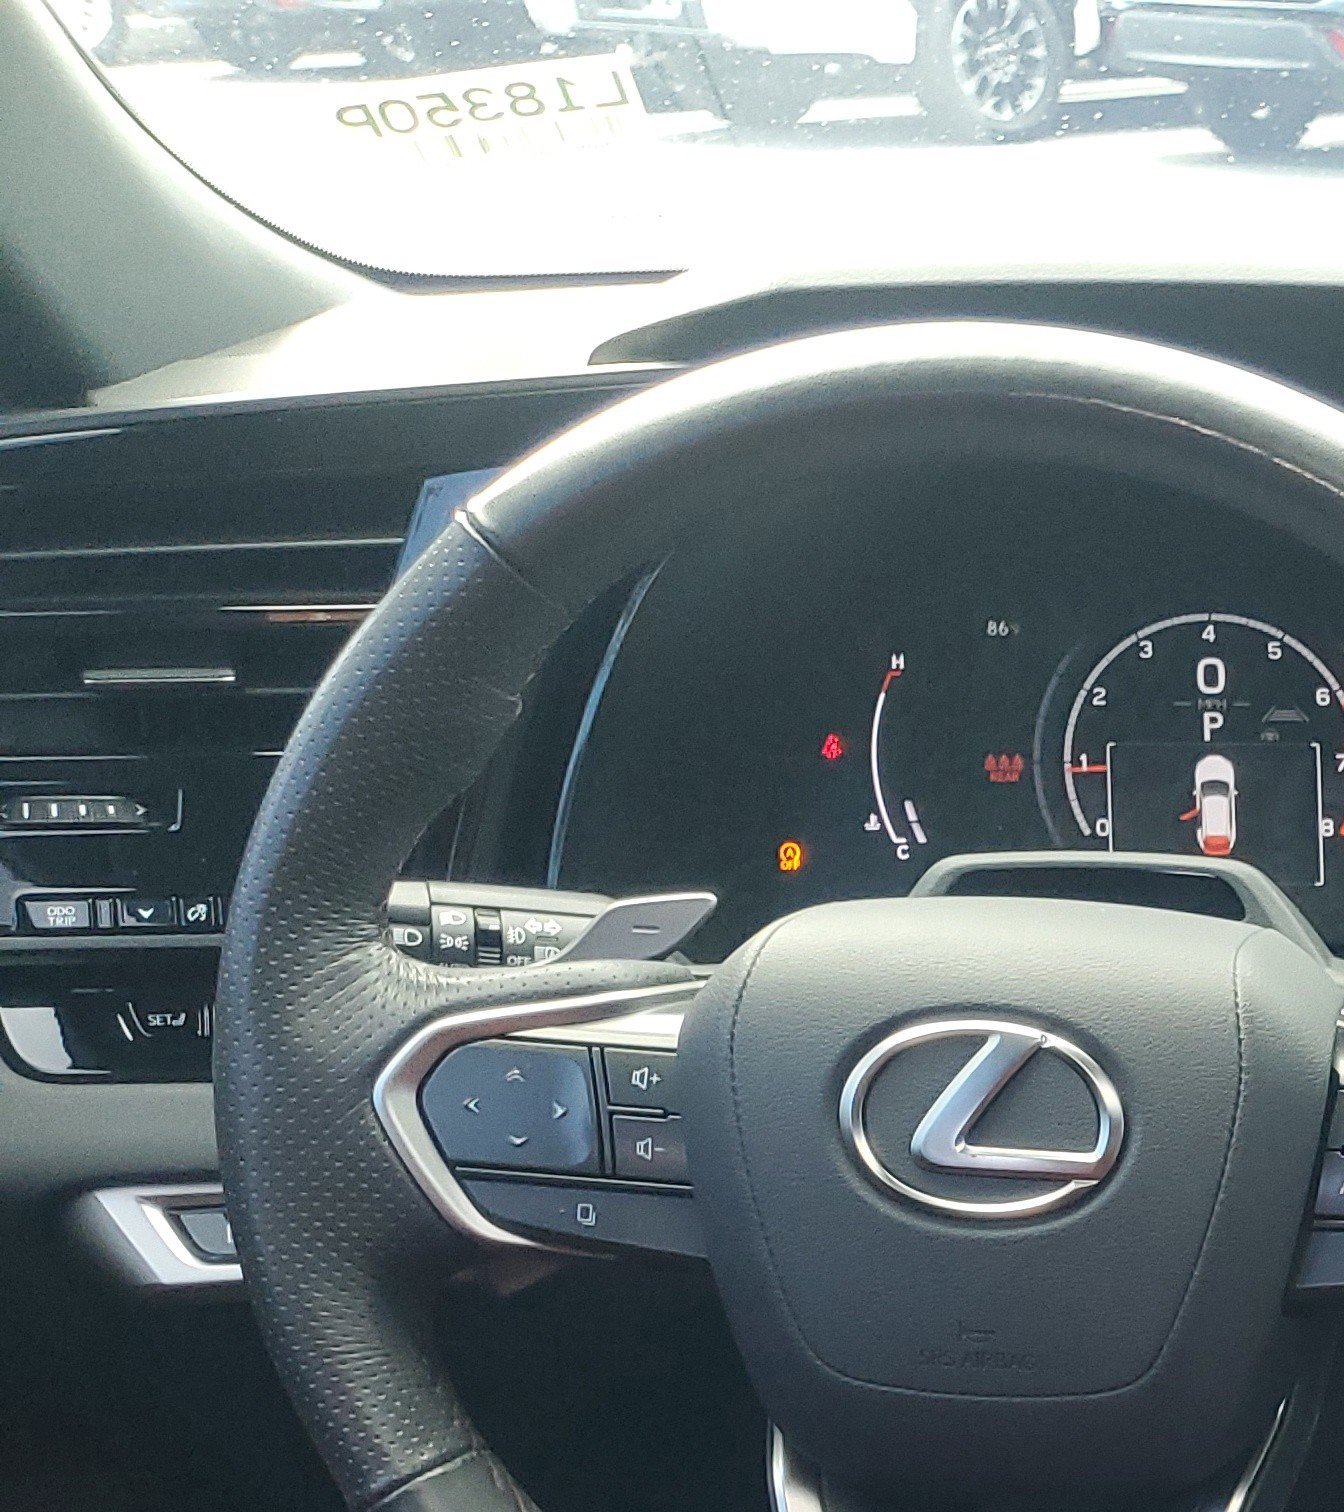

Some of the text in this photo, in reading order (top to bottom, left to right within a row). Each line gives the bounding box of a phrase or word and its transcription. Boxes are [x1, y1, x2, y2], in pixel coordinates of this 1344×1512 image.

[1202, 625, 1216, 642] 4
[1139, 640, 1153, 658] 3
[1267, 642, 1283, 660] 5
[891, 653, 905, 669] H
[1092, 687, 1107, 706] 2
[1315, 687, 1330, 706] 6
[1203, 711, 1224, 742] P
[1080, 753, 1088, 771] 1
[1095, 818, 1109, 837] 0
[1322, 818, 1335, 837] 8
[896, 845, 910, 860] C
[47, 916, 77, 927] TRIP
[147, 1013, 172, 1027] SET
